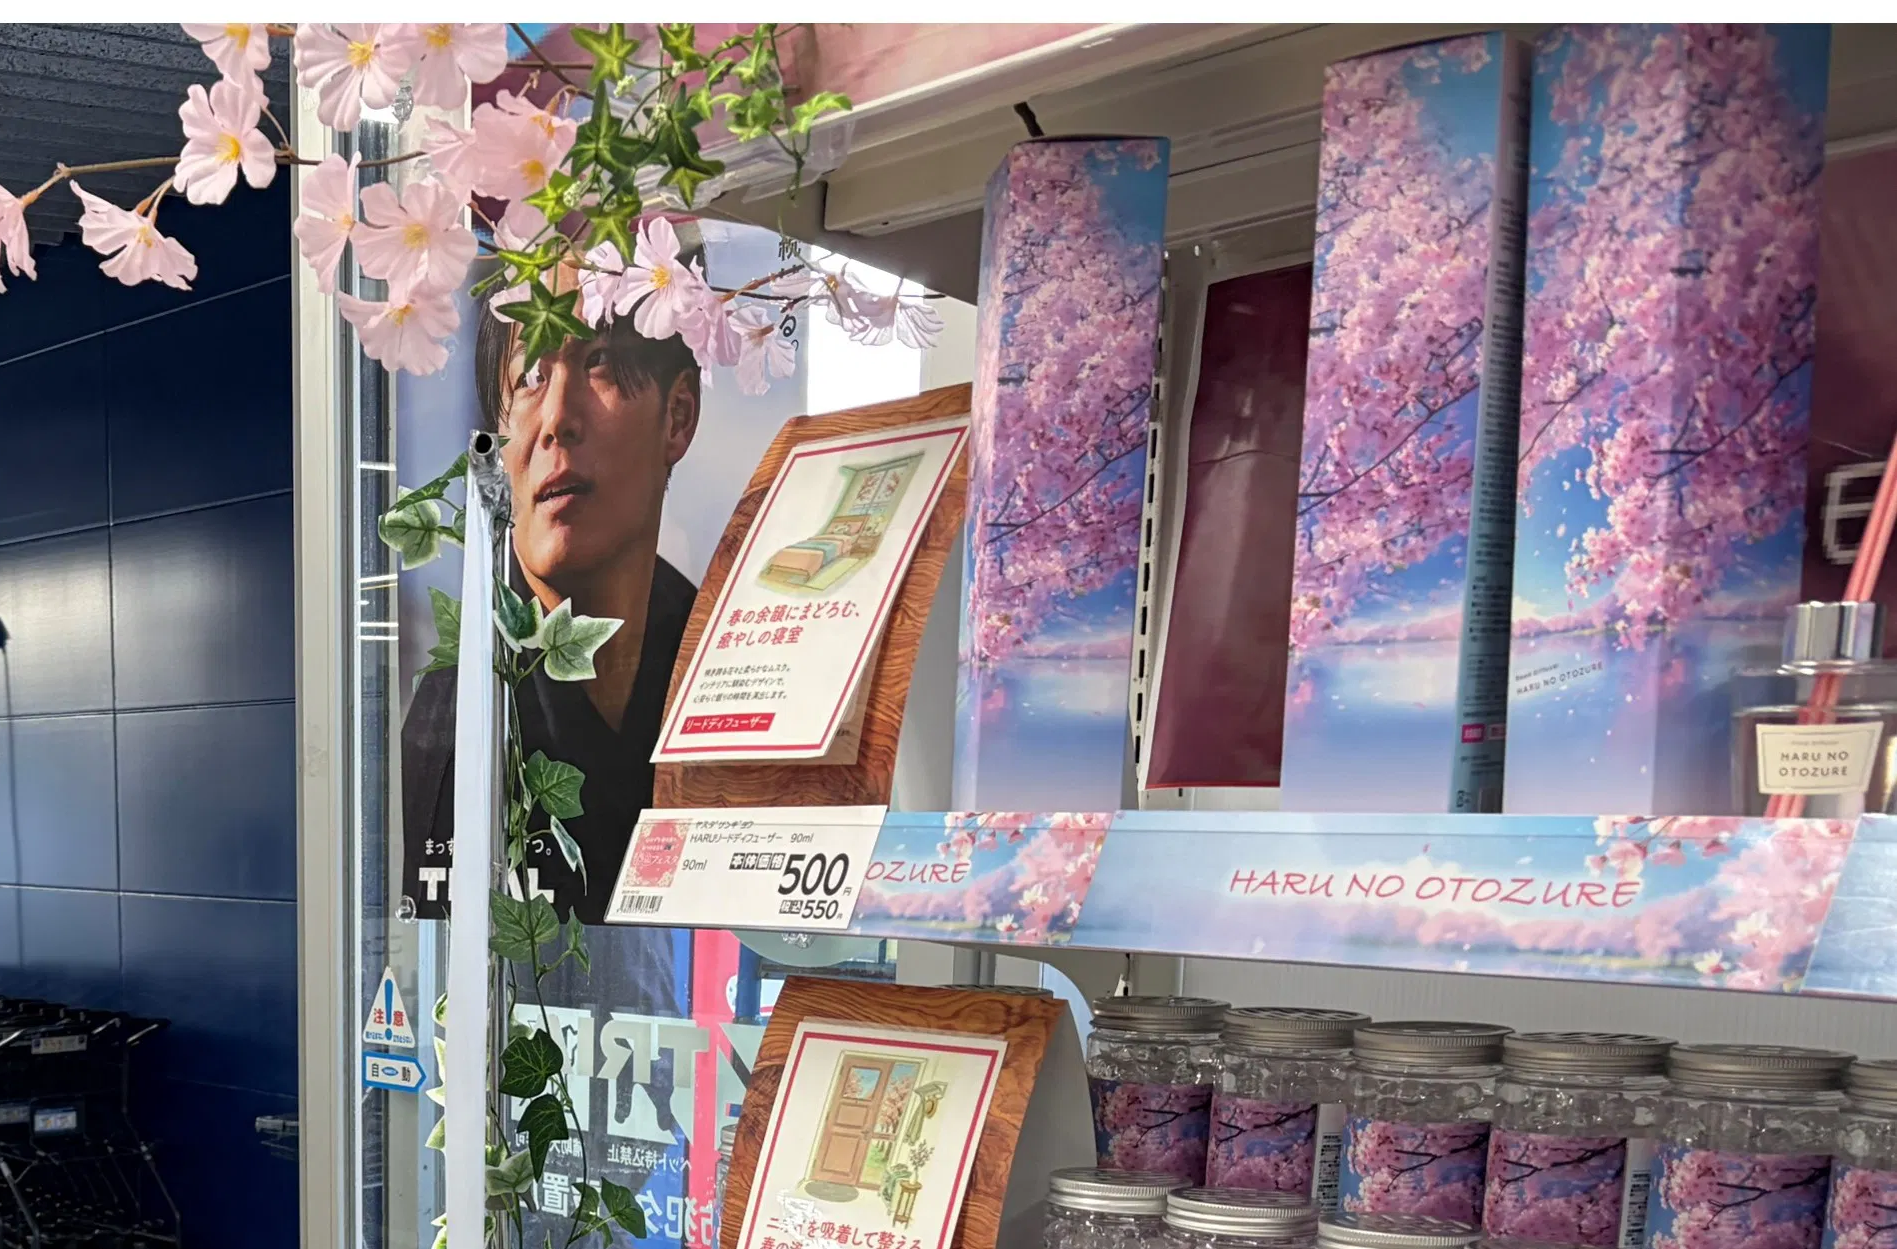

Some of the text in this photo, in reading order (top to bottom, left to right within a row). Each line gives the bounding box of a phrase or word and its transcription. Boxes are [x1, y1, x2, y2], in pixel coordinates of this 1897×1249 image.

[727, 600, 861, 626] 春の余韻にまどろむ、
[716, 627, 803, 650] 癒やしの寝室
[686, 715, 770, 731] リードディフューザー
[1780, 750, 1850, 762] HARU NO
[1779, 765, 1849, 778] OTOZURE
[790, 833, 814, 844] 90ml
[681, 859, 707, 871] 90ml
[866, 859, 970, 884] OZURE
[1229, 866, 1641, 909] HARU NO OTOZURE
